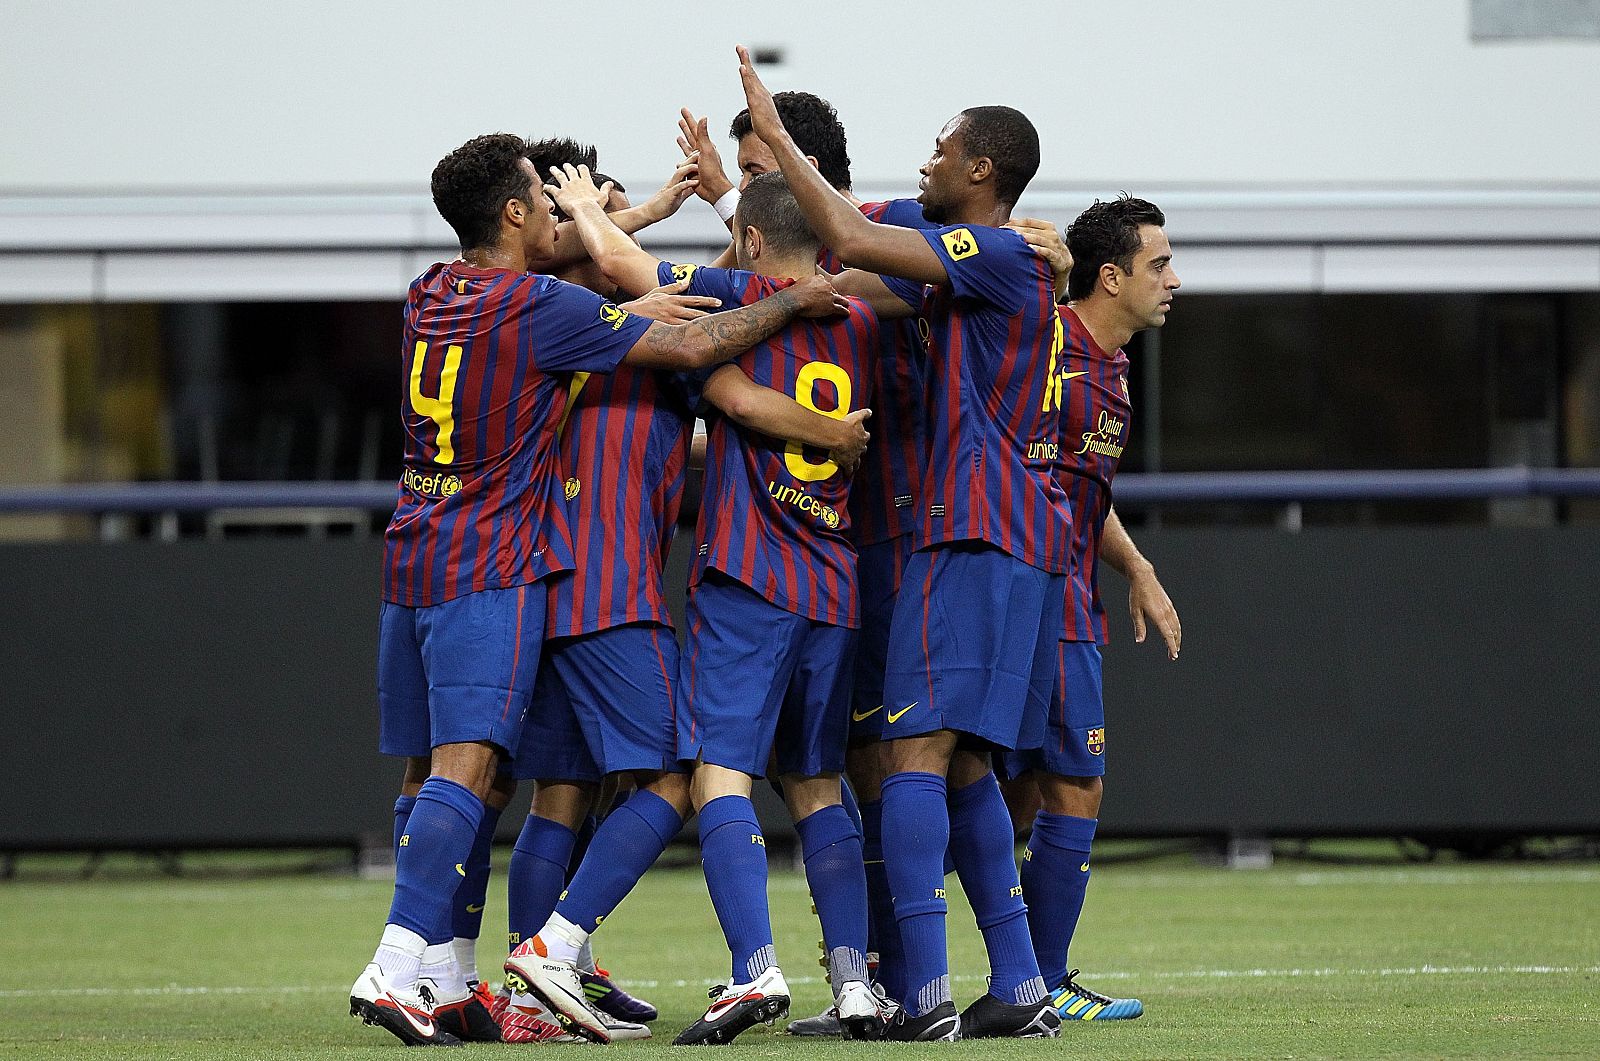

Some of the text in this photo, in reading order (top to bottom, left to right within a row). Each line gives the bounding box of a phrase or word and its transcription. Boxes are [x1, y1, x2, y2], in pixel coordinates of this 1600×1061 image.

[952, 240, 971, 256] 3
[409, 341, 463, 465] 4
[784, 361, 852, 482] 8
[1097, 410, 1124, 439] Qatar
[1028, 437, 1058, 460] unice
[1073, 432, 1124, 459] Foundation
